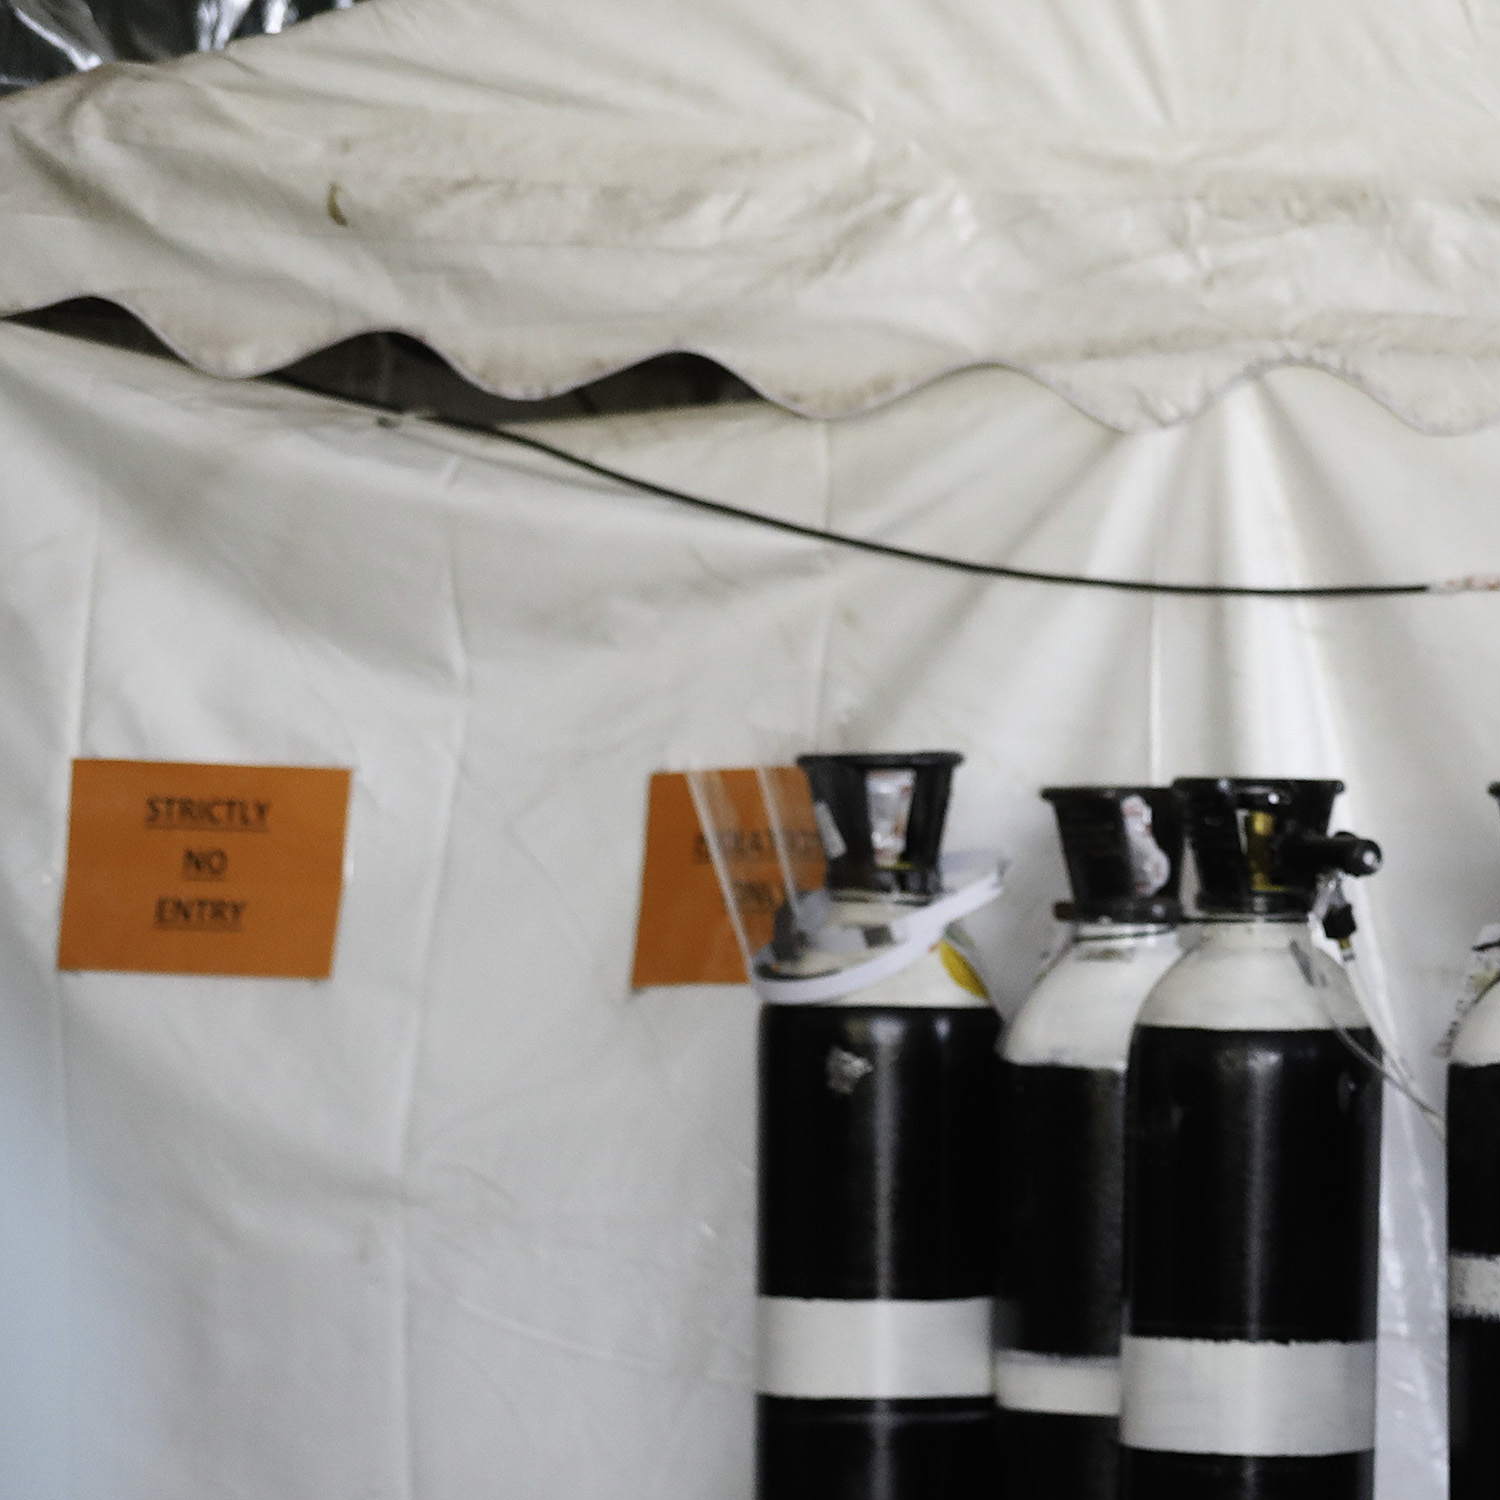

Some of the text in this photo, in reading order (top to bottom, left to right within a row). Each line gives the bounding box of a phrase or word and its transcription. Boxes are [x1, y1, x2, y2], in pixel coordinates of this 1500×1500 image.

[146, 796, 270, 829] STRICTLY
[182, 849, 228, 880] NO
[155, 898, 246, 929] ENTRY
